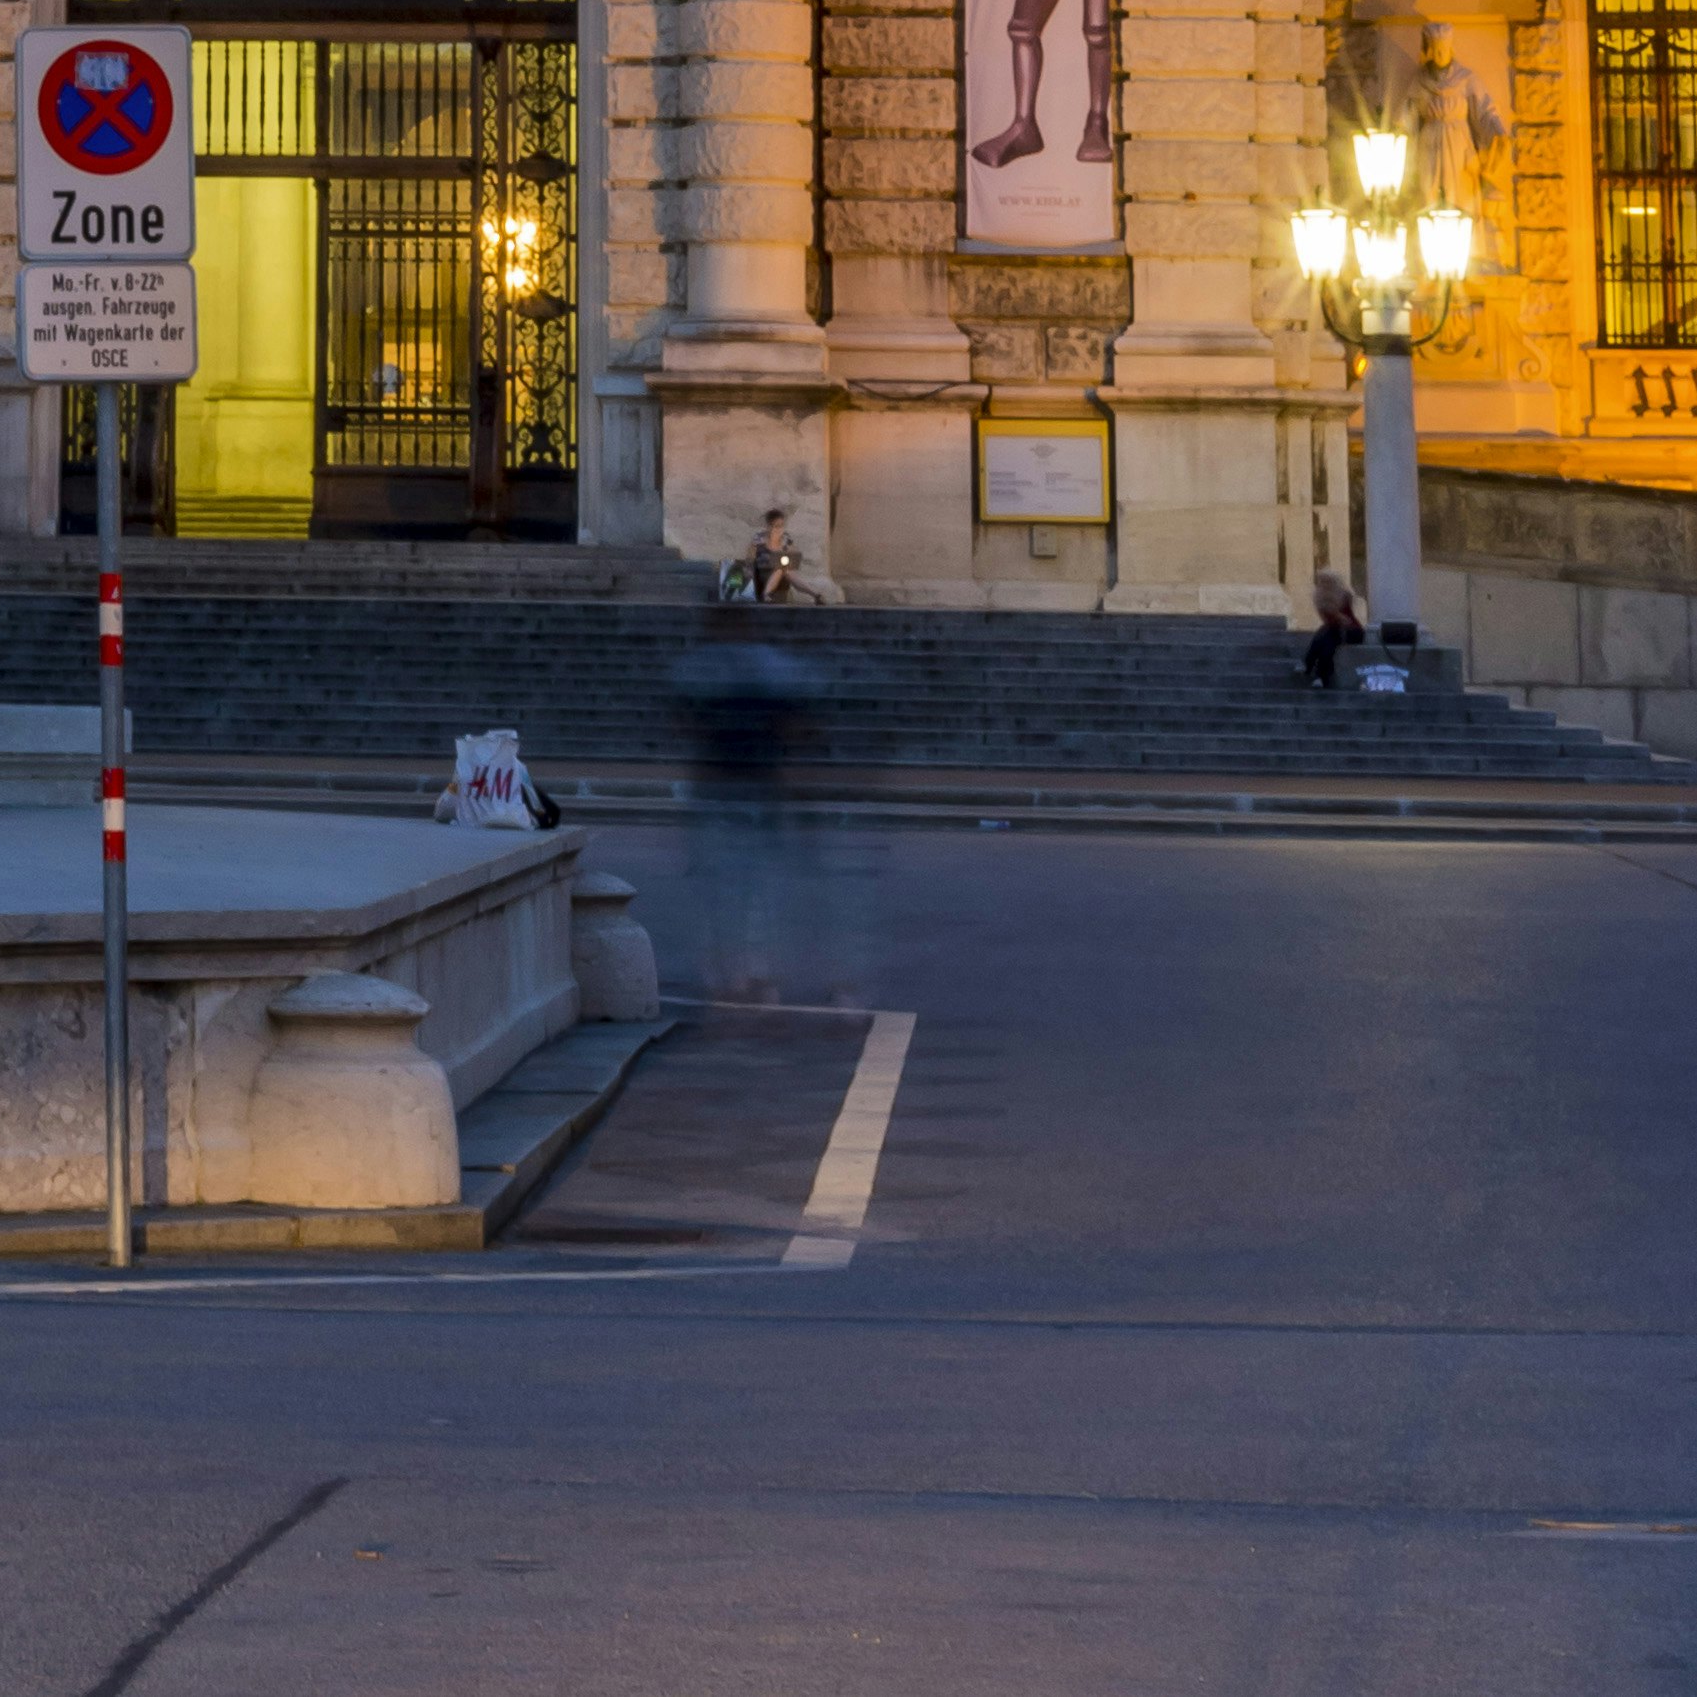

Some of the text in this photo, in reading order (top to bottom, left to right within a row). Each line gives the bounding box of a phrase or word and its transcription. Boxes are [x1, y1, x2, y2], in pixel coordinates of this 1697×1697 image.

[51, 190, 165, 245] Zone
[42, 296, 176, 321] ausgen. Fahrzeuge
[33, 322, 186, 347] mit Wagenkarte der
[91, 348, 129, 368] OSCE
